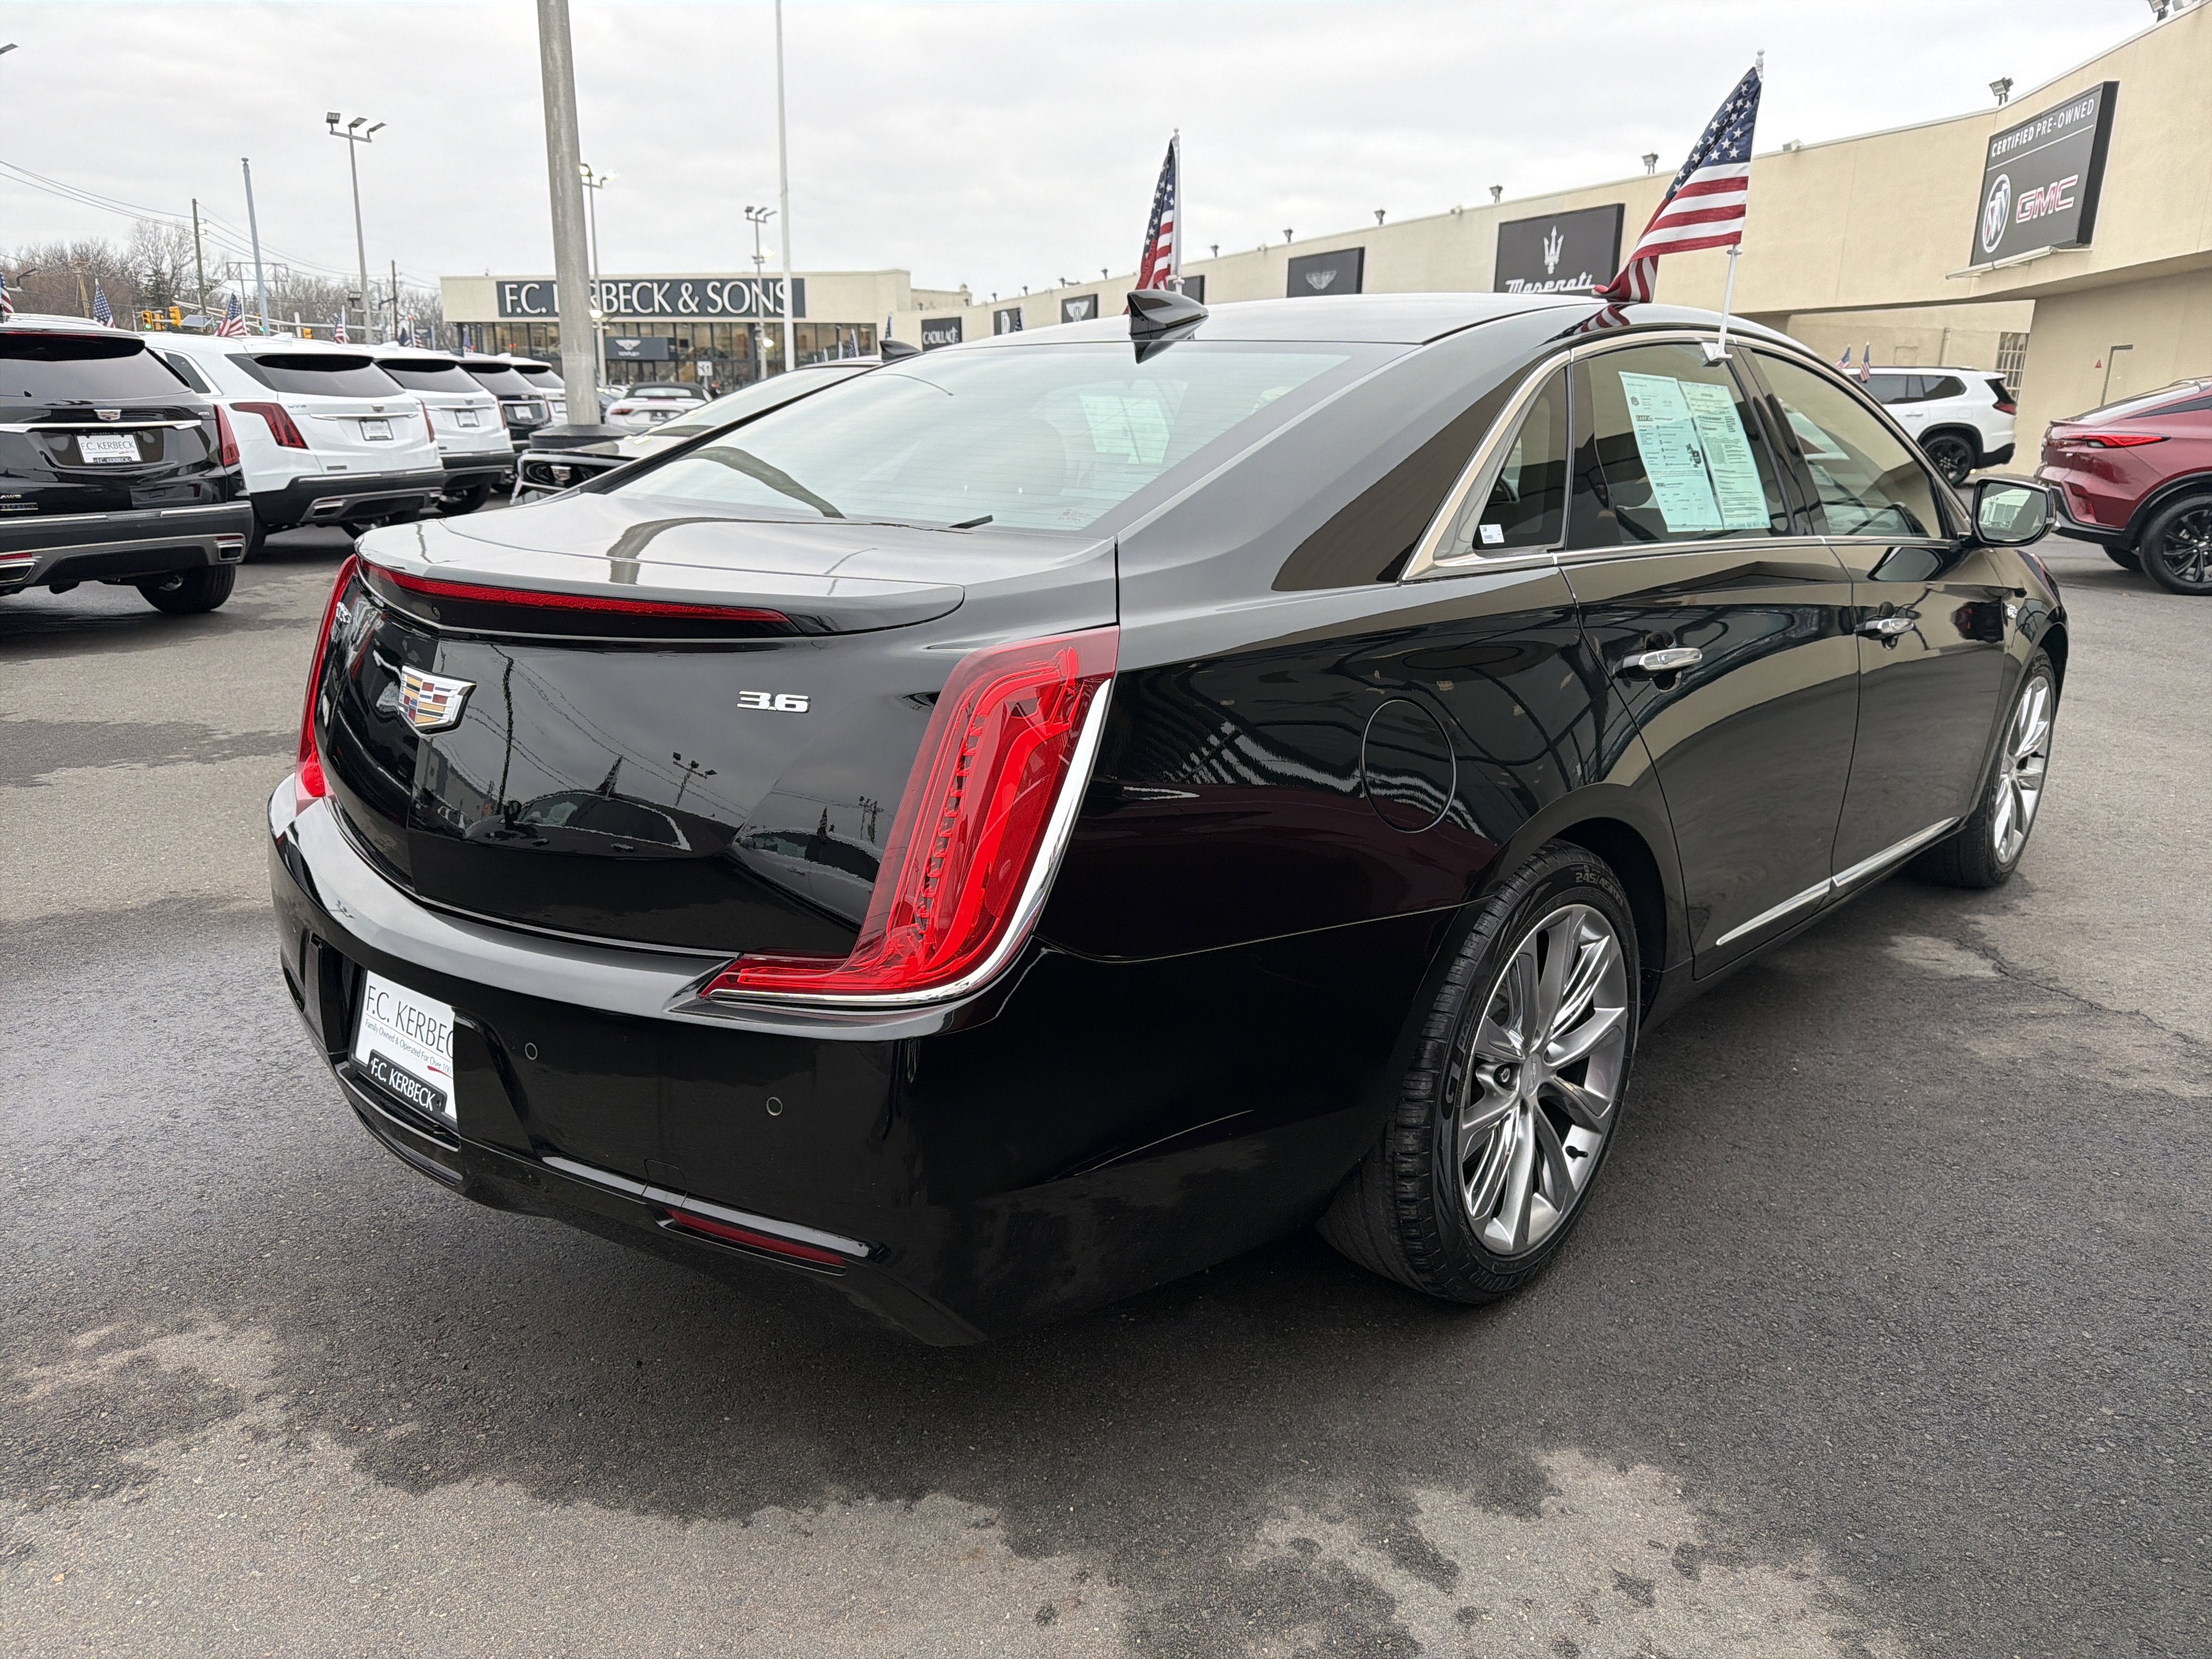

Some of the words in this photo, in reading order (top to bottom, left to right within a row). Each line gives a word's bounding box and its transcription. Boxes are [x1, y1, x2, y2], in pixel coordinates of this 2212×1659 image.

[1991, 126, 2034, 157] CERTIFIED
[2036, 99, 2095, 138] PRE-OWNED
[2016, 174, 2079, 224] GMC
[504, 283, 546, 314] F.C.
[678, 282, 699, 314] &
[1505, 271, 1595, 293] Maserati
[81, 442, 96, 450] F.C.
[97, 441, 136, 450] KERBECK
[365, 1019, 379, 1034] Family
[379, 1028, 395, 1042] Owned
[395, 1036, 399, 1045] &
[399, 1039, 421, 1057] Operated
[421, 1051, 430, 1062] For
[430, 1056, 442, 1068] Over
[443, 1063, 452, 1075] 100
[366, 985, 390, 1023] F.C.
[396, 1001, 454, 1059] KERBEC
[371, 1057, 387, 1082] F.C.
[388, 1068, 436, 1111] KERBECK
